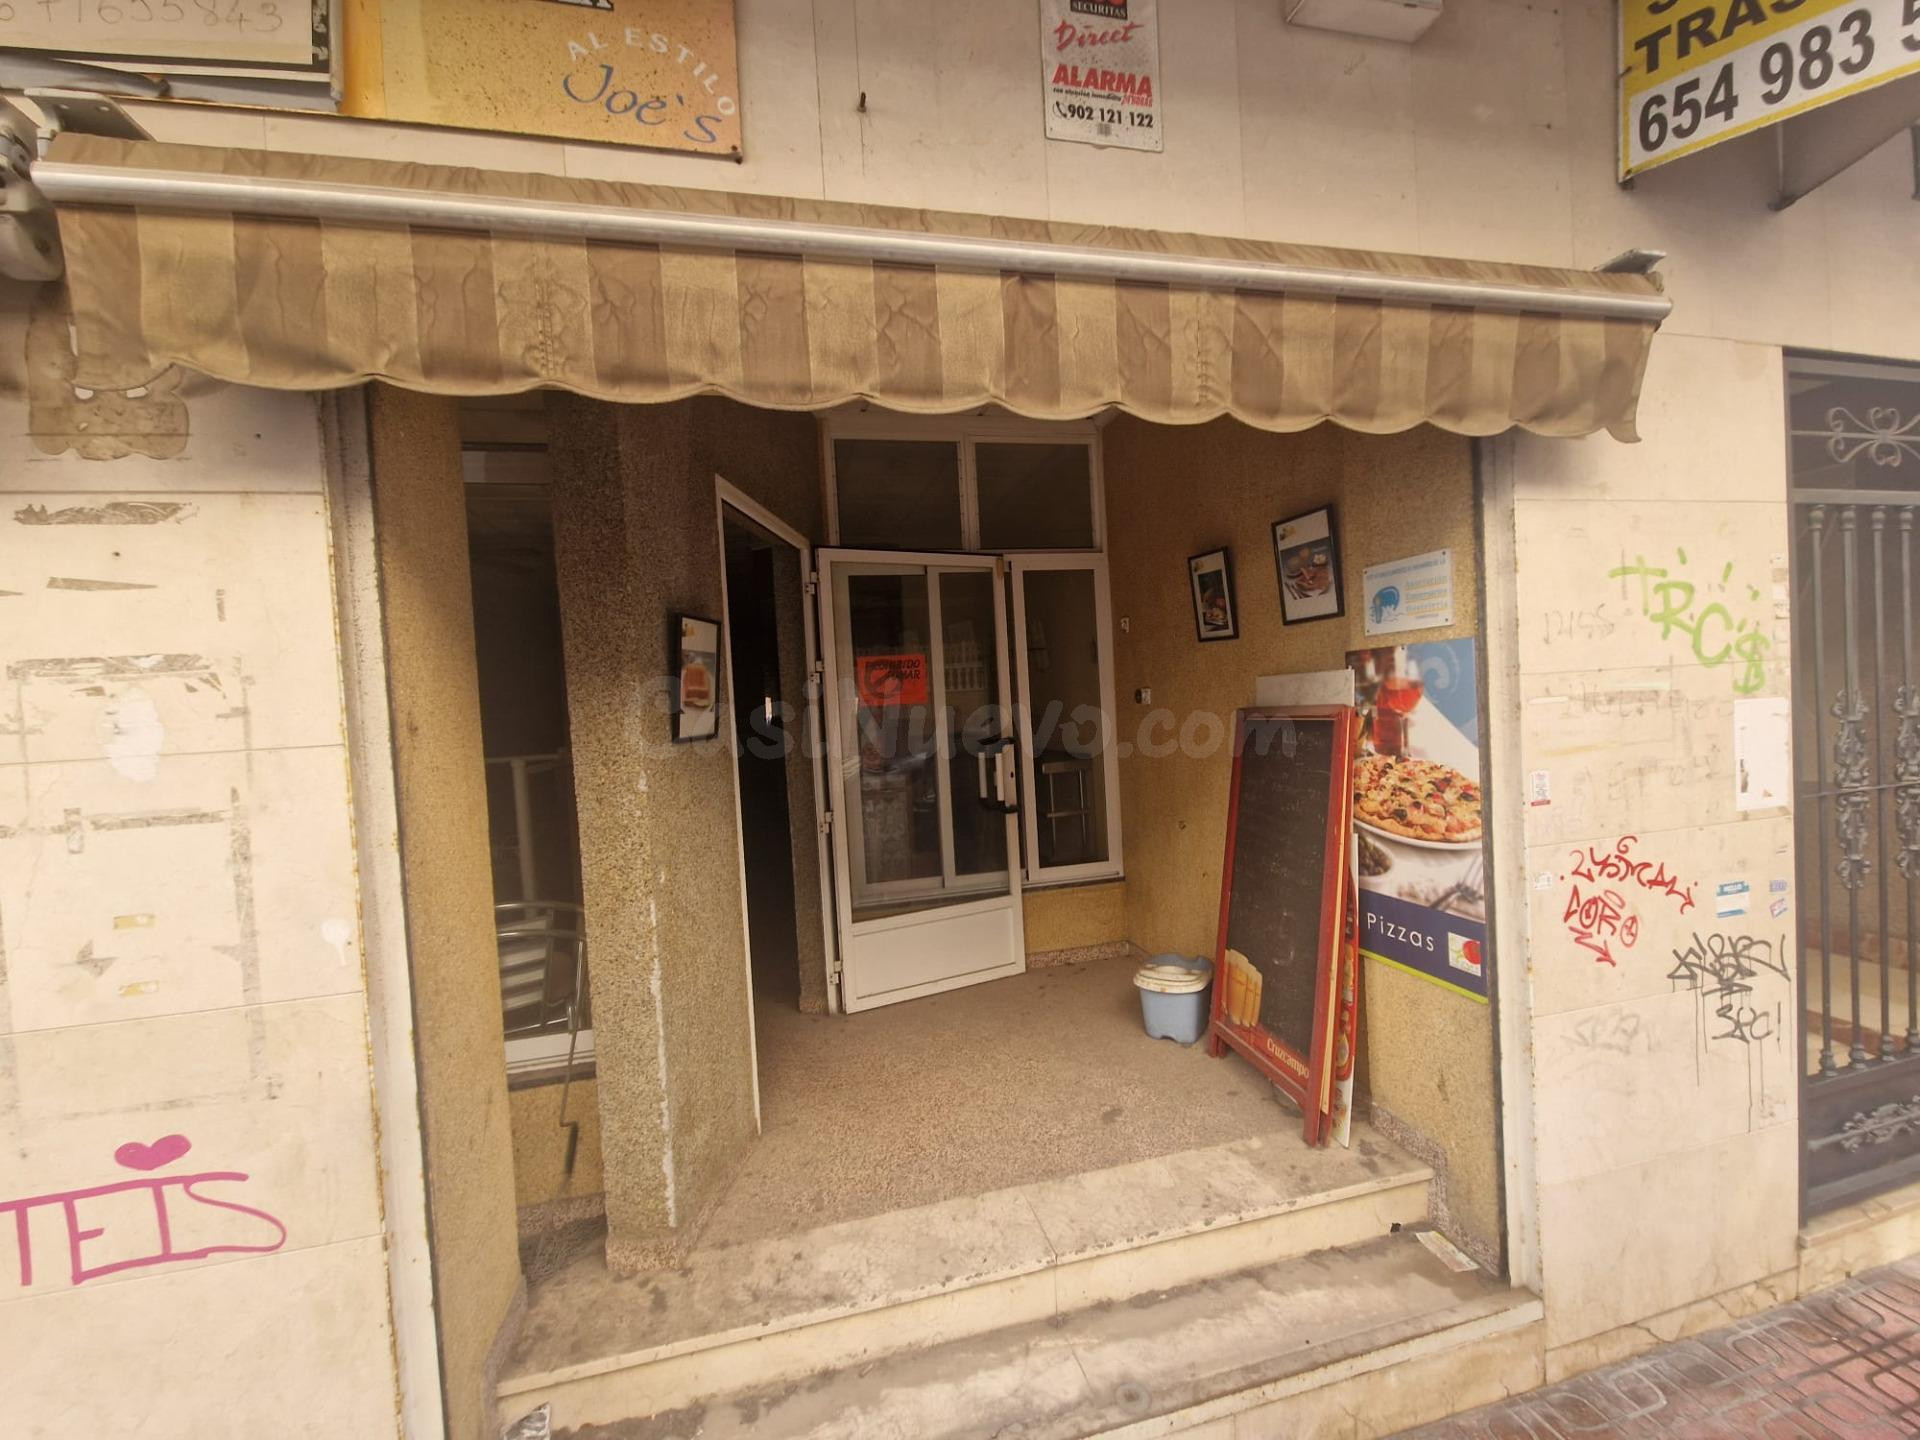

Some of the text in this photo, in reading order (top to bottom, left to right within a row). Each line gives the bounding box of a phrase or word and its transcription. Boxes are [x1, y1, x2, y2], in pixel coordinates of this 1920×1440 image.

[1053, 20, 1145, 52] Direct
[1634, 0, 1806, 74] TRA
[567, 27, 736, 115] AL ESTILO
[1052, 63, 1153, 98] ALARMA
[1639, 61, 1738, 152] 654
[1760, 8, 1875, 105] 983
[563, 64, 722, 143] Joe's
[1067, 103, 1093, 121] 902
[1099, 107, 1122, 125] 121
[1129, 111, 1153, 129] 122
[1367, 912, 1434, 952] Pizzas
[1266, 1037, 1310, 1078] Cruzcampo
